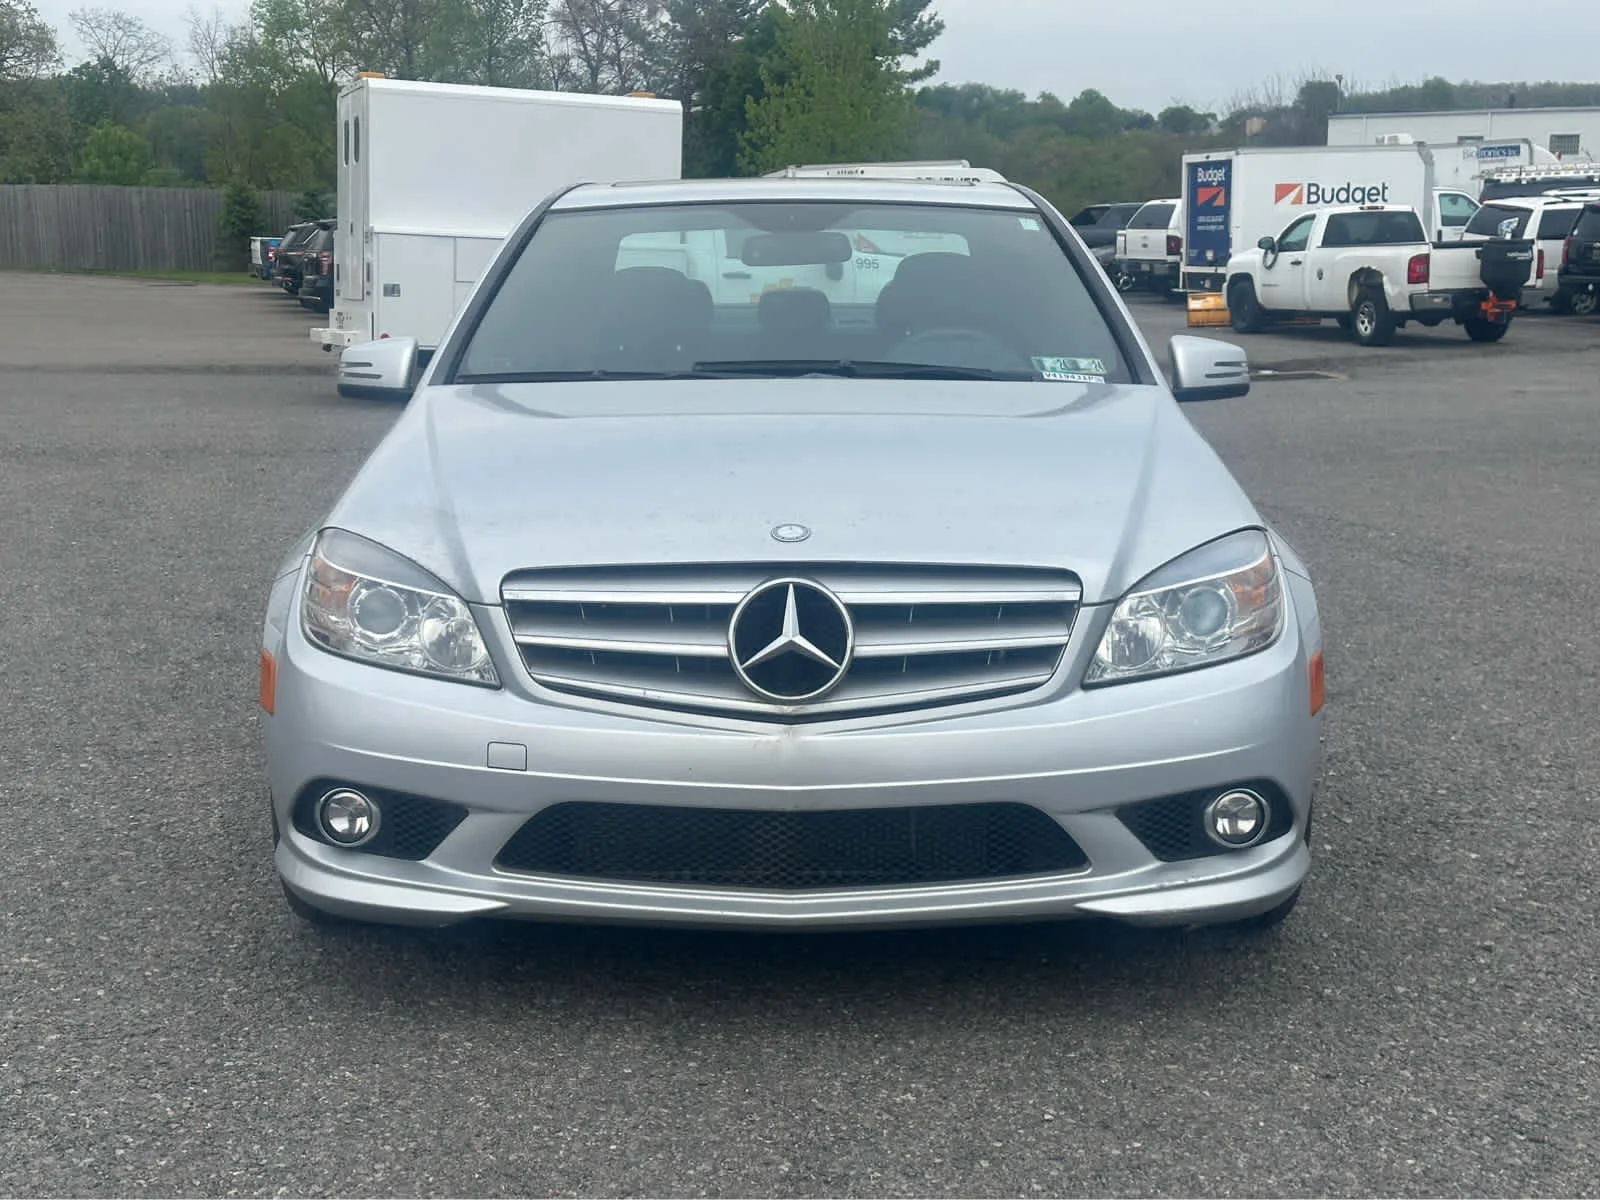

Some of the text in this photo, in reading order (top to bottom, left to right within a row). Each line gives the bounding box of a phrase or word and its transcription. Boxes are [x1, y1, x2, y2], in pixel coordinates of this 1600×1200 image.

[1197, 167, 1225, 185] Budget
[1307, 182, 1388, 205] Budget
[856, 257, 879, 269] 995
